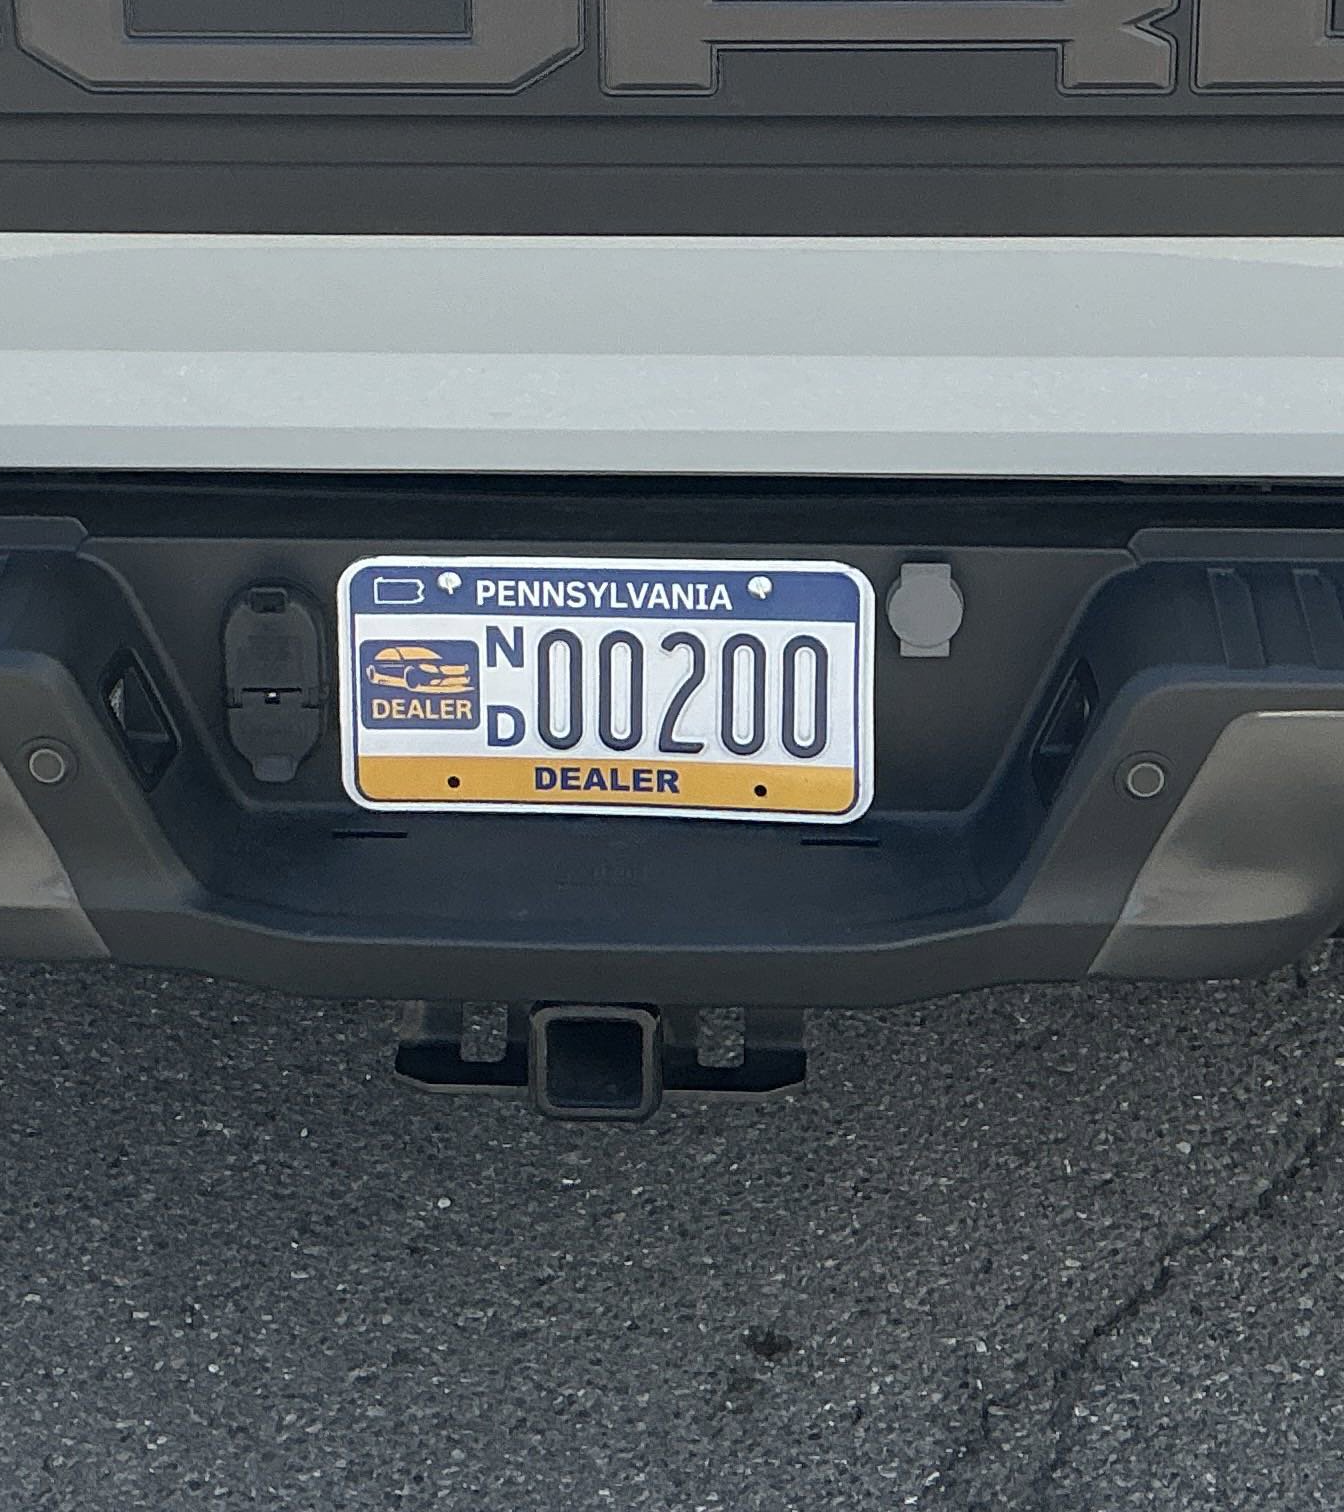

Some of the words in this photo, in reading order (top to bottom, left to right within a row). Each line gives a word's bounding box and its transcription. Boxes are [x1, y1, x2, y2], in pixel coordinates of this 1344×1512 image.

[476, 579, 733, 612] PENNSYLVANIA
[537, 628, 829, 759] 00200
[371, 698, 473, 722] DEALER
[534, 766, 680, 794] DEALER
